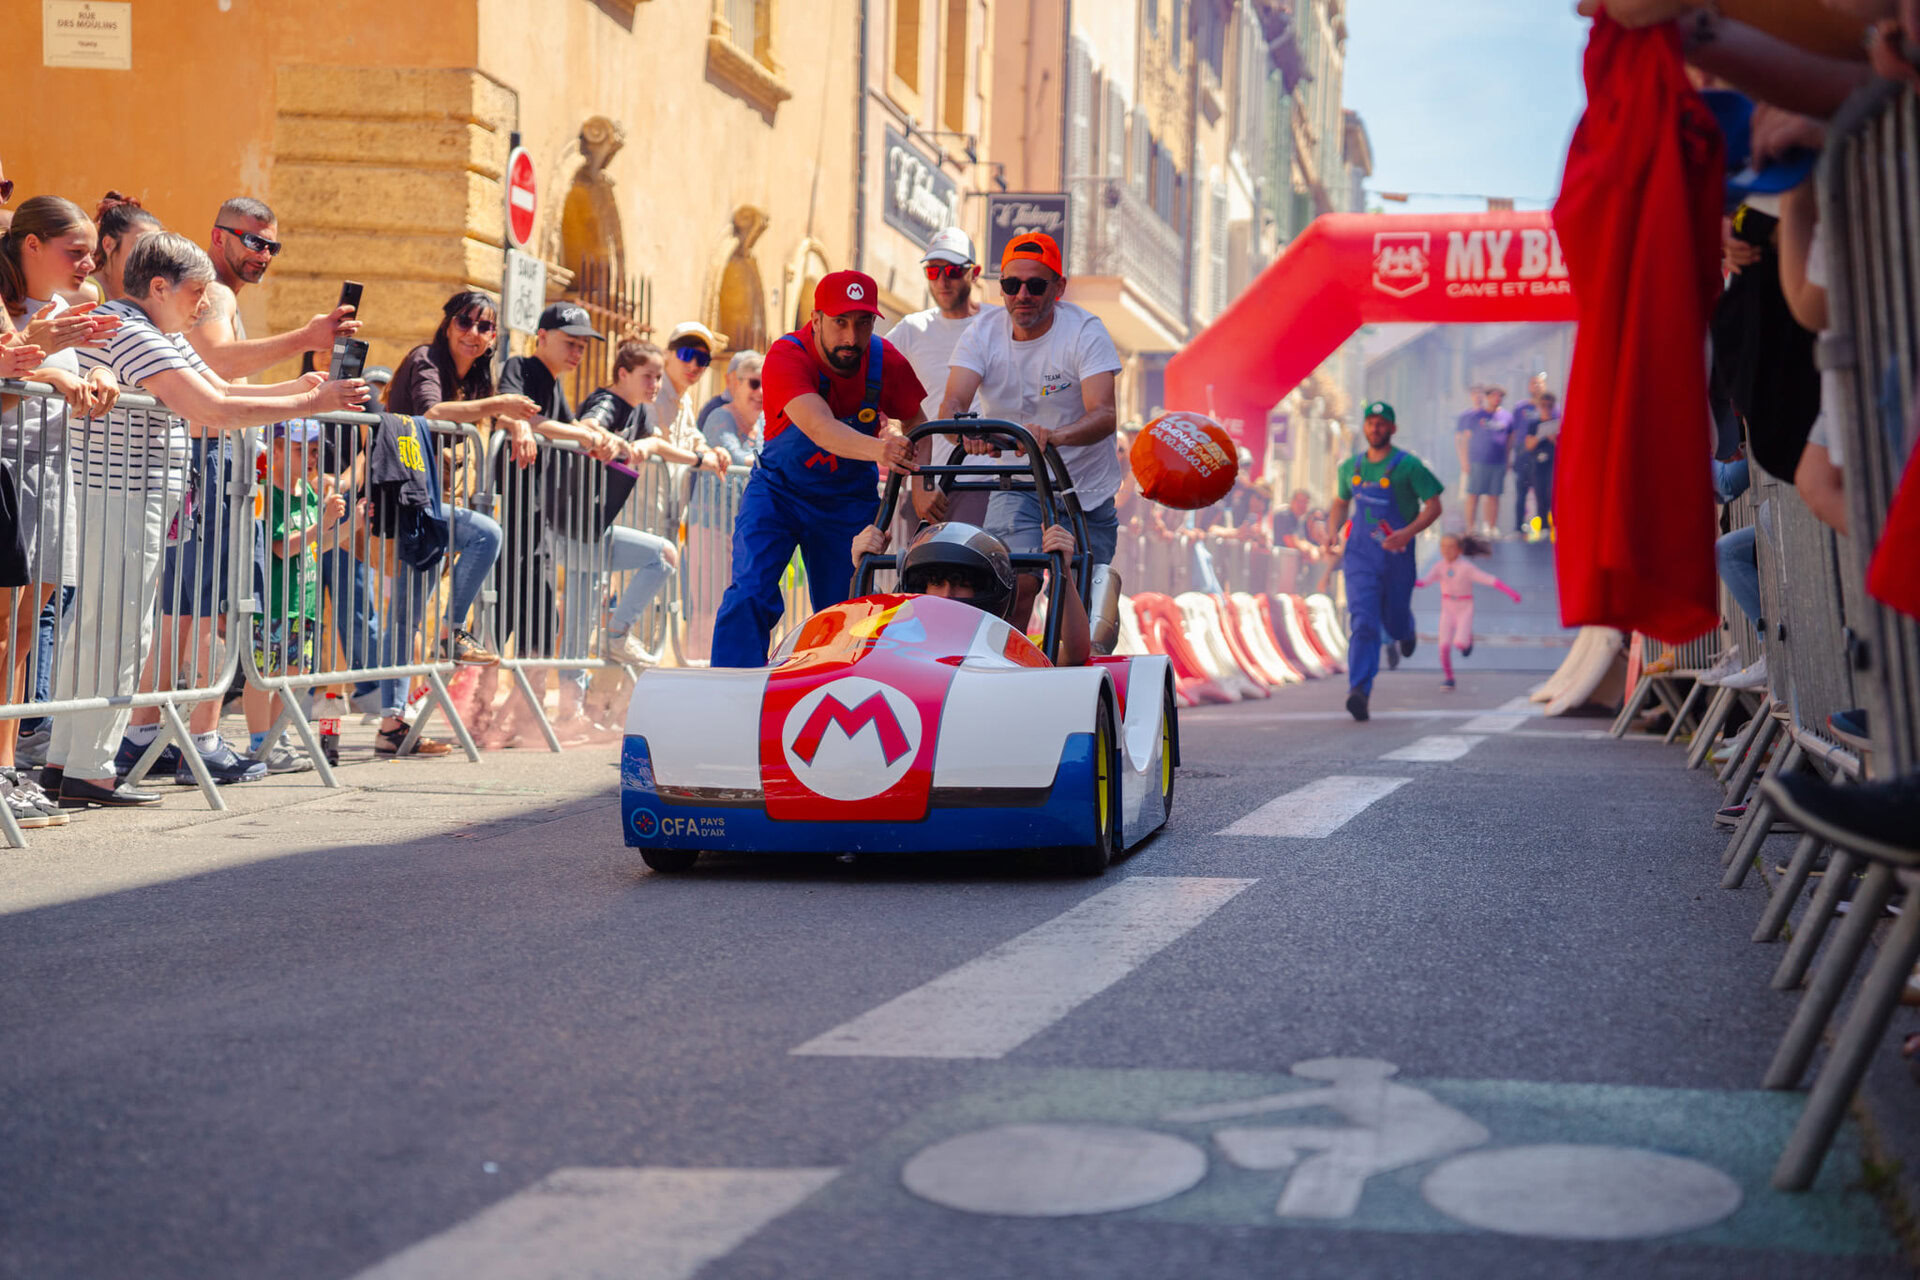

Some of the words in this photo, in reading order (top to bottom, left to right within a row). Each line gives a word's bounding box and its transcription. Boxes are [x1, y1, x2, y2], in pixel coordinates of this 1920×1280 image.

[57, 19, 74, 28] DES
[76, 20, 118, 30] MOULINS
[78, 12, 96, 20] RUE
[1445, 230, 1513, 280] MY
[518, 258, 538, 281] SAUF
[849, 286, 863, 296] M
[1446, 282, 1499, 298] CAVE
[1502, 281, 1527, 296] ET
[1530, 281, 1571, 295] BAR
[1044, 374, 1061, 382] TEAM
[1149, 428, 1213, 478] 04.90.50.60.53
[804, 451, 839, 473] M
[1365, 507, 1379, 523] L
[791, 690, 912, 768] M
[661, 818, 700, 836] CFA
[700, 818, 725, 826] PAYS
[701, 828, 725, 837] D'AIX
